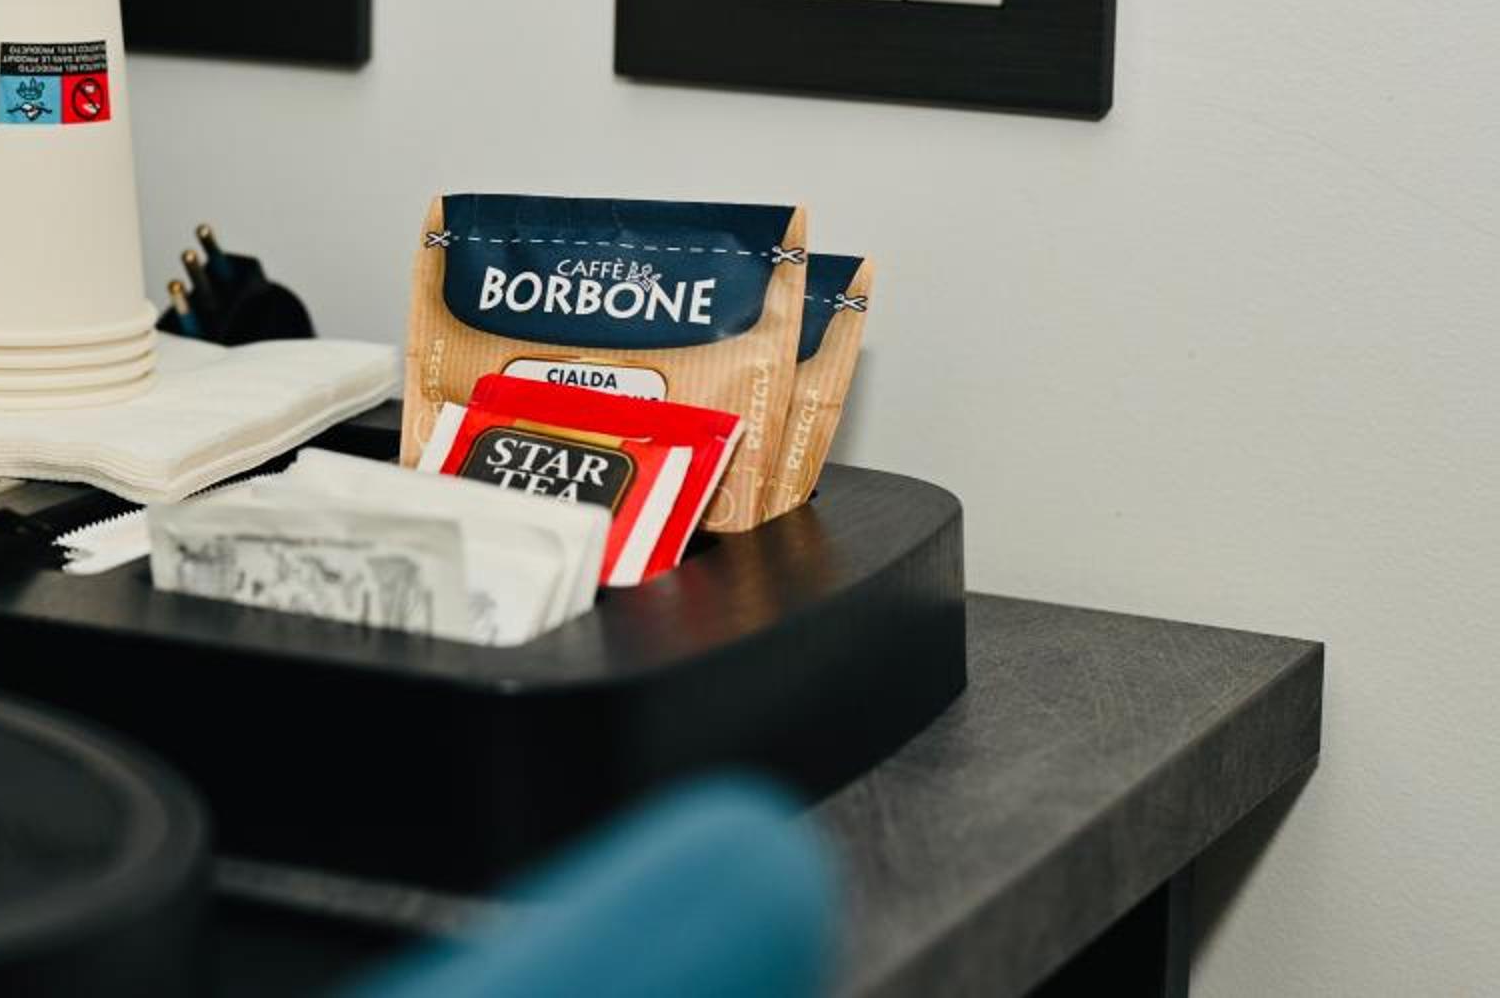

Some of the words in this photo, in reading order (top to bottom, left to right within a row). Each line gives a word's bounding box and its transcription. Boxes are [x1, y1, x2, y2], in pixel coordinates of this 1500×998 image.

[557, 258, 625, 280] CAFFÈ
[478, 265, 716, 325] BORBONE
[546, 367, 618, 390] CIALDA
[787, 388, 820, 471] RICICLA
[485, 437, 609, 486] STAR
[492, 467, 579, 503] TEA
